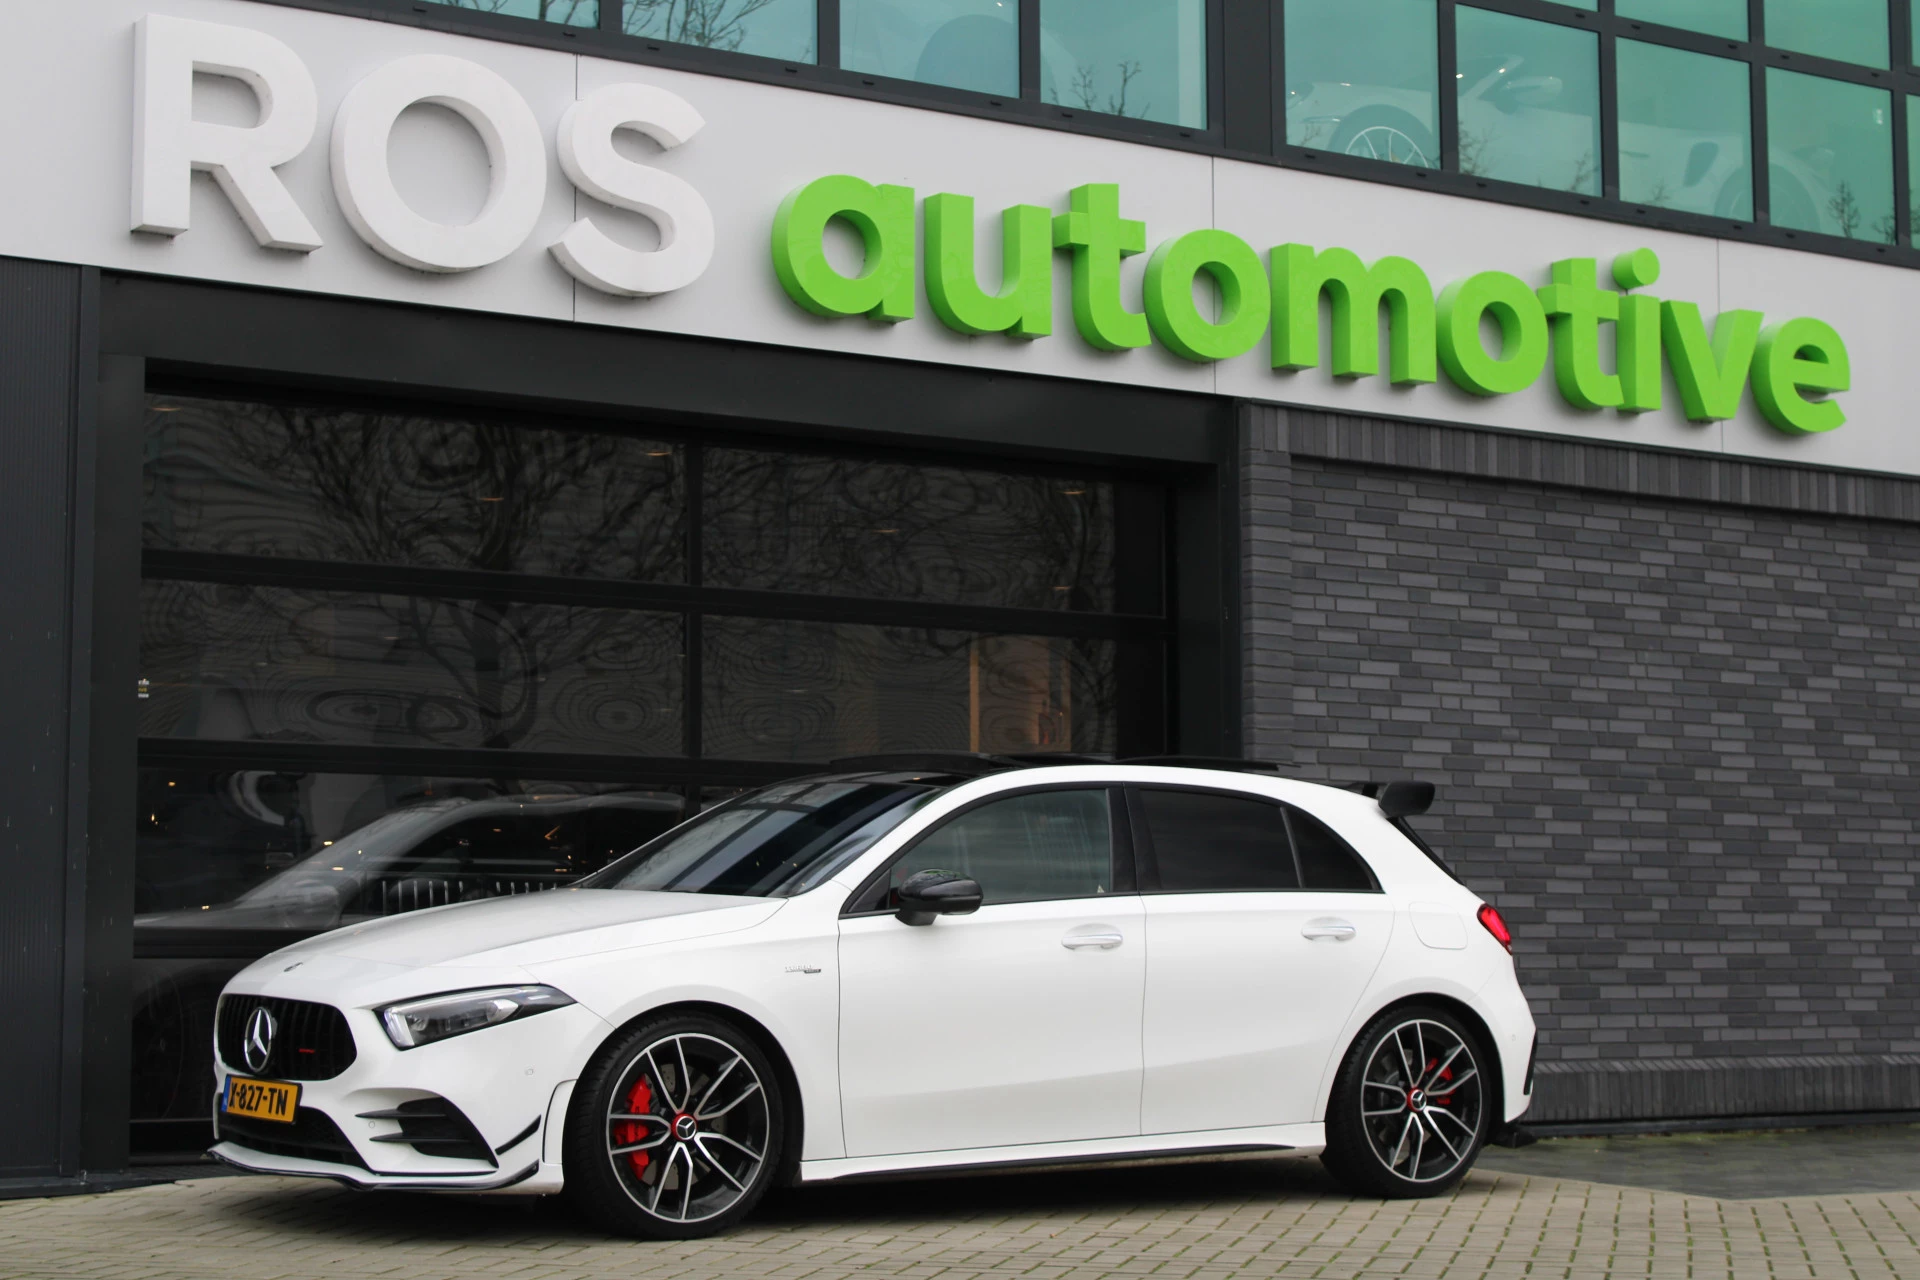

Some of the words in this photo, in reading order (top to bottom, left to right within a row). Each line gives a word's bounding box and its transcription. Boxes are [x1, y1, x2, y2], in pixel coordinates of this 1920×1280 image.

[131, 14, 716, 298] ROS
[771, 174, 1850, 435] automotive
[228, 1082, 289, 1116] X-827-TN
